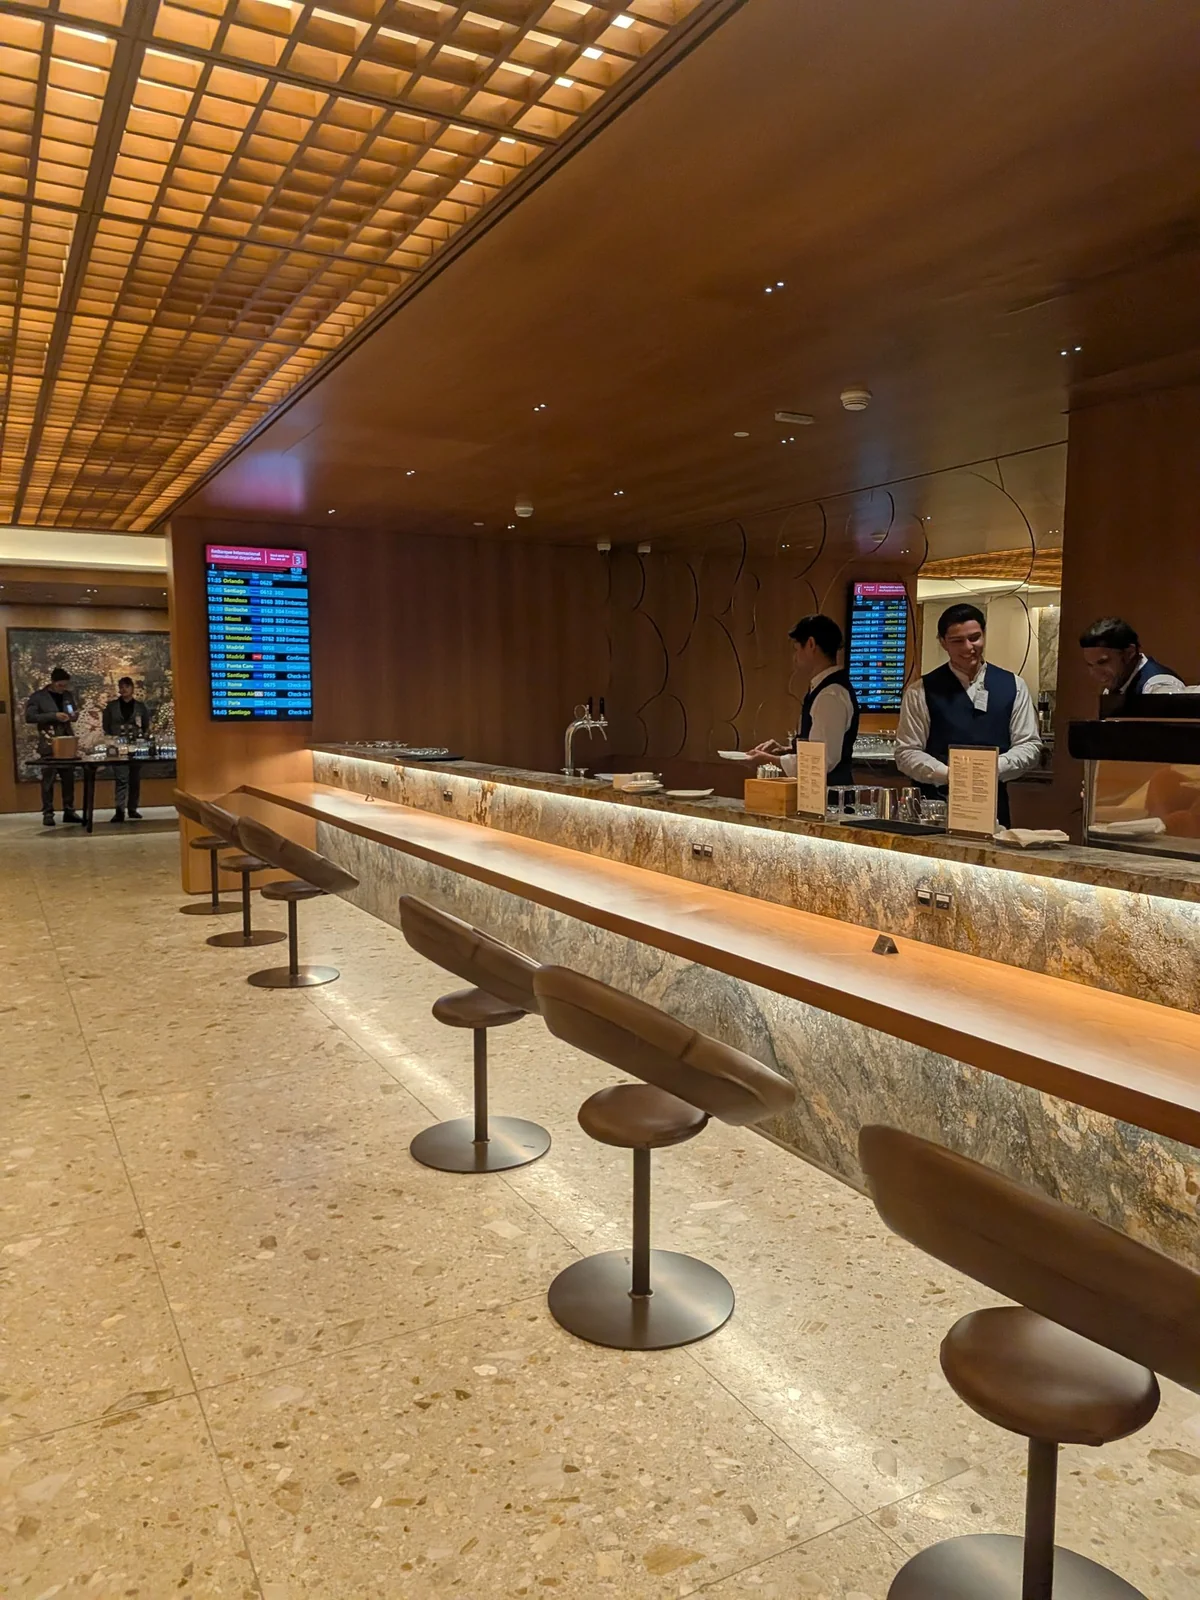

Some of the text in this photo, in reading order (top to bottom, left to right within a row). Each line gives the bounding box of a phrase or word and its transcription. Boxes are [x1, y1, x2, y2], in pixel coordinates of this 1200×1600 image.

[222, 577, 245, 585] Orlando
[223, 587, 247, 595] Santiago
[226, 643, 245, 651] Madrid
[227, 672, 250, 680] Santiago
